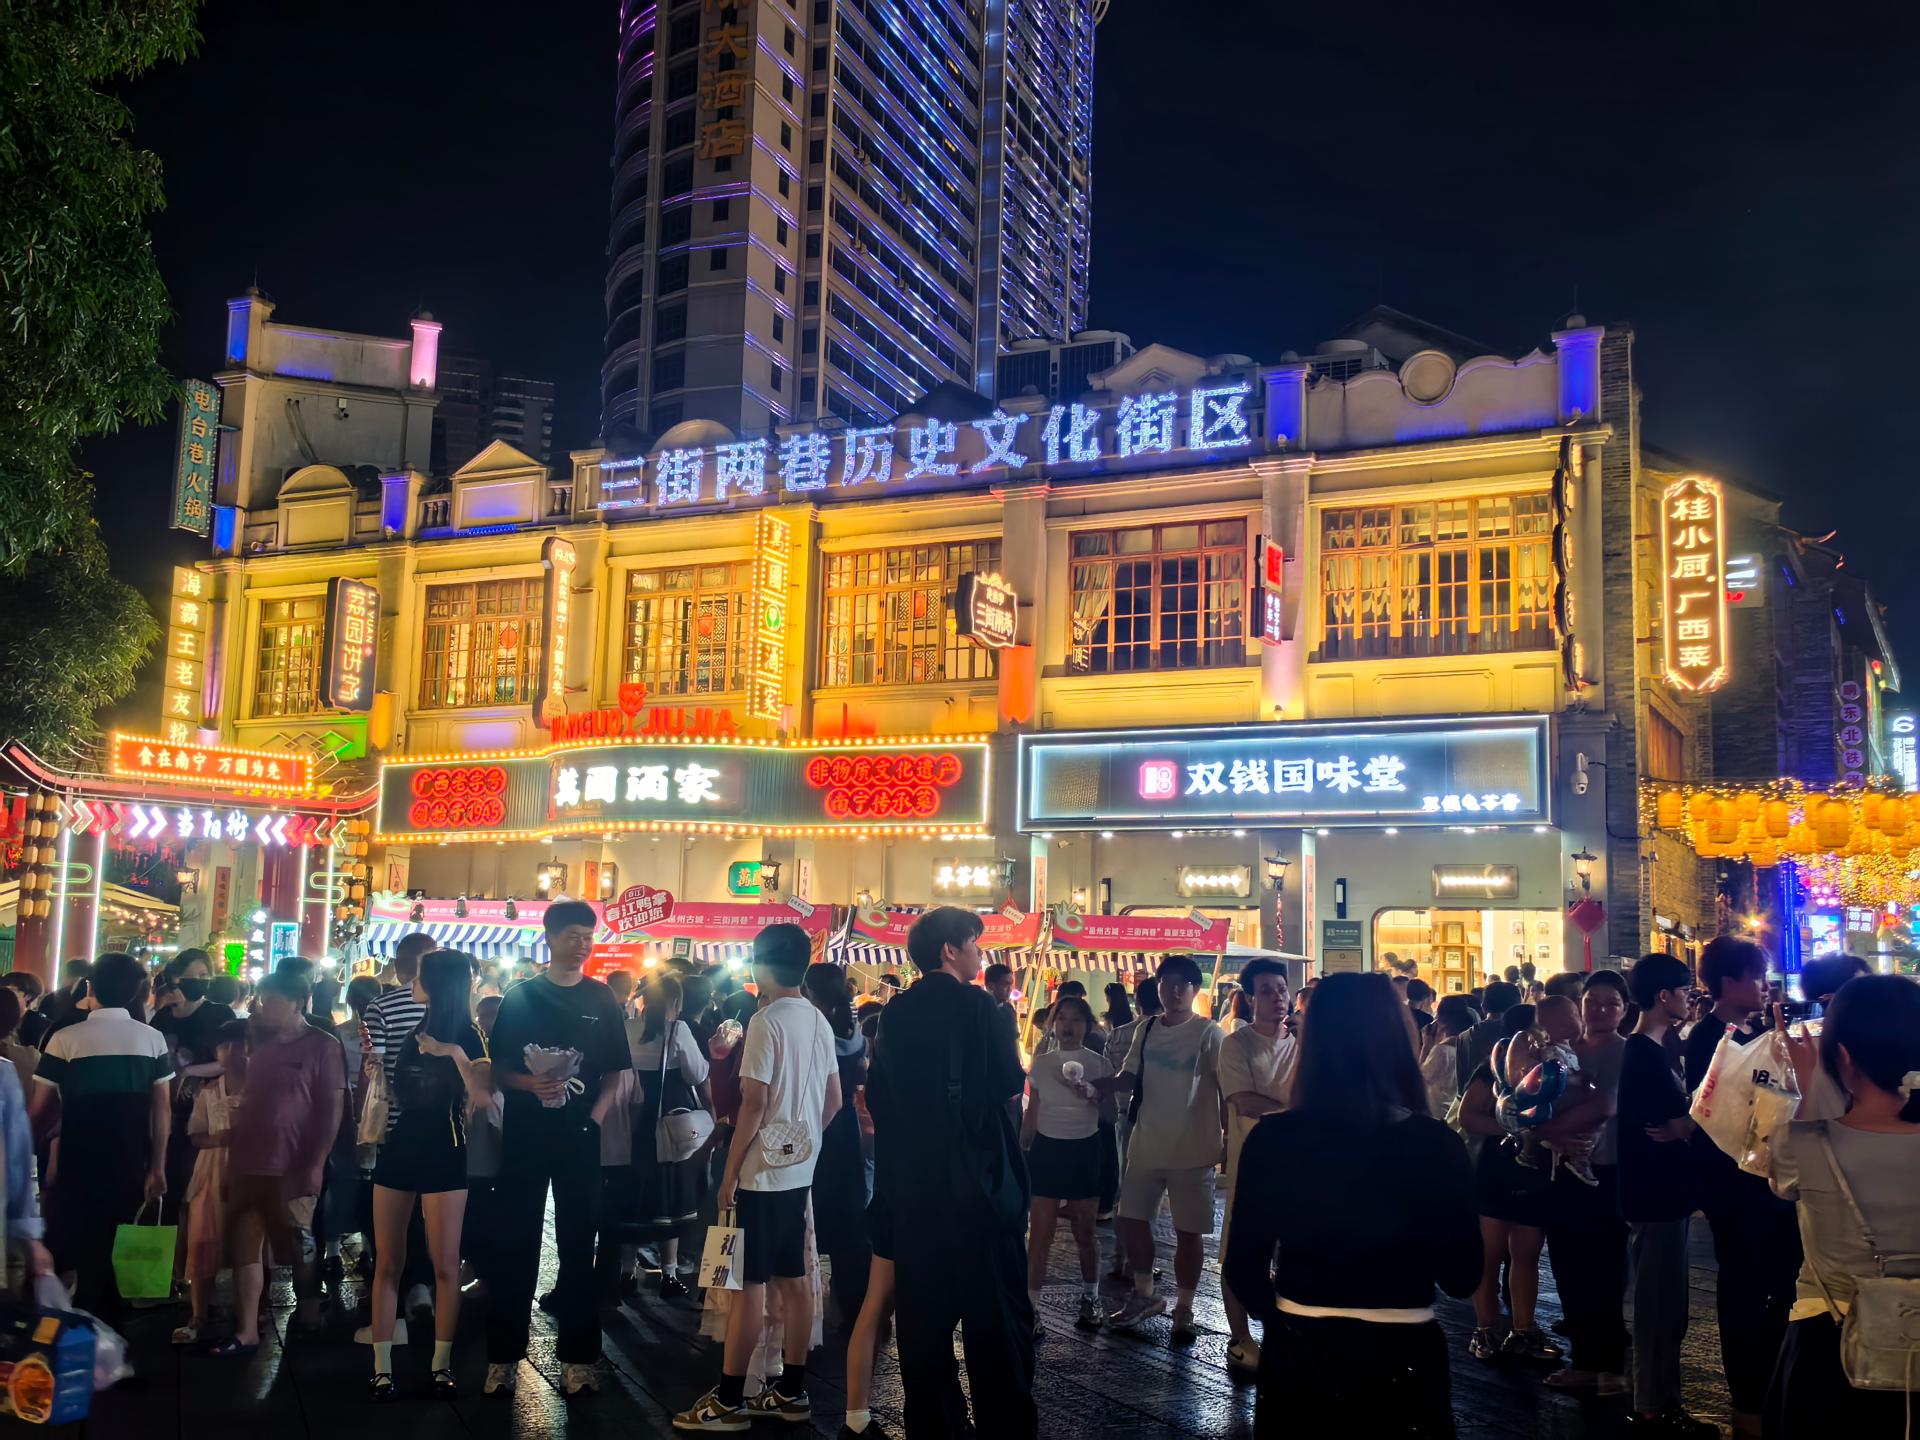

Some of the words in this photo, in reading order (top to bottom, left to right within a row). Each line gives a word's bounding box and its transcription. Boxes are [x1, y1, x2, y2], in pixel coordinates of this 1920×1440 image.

[700, 0, 750, 160] 大酒店
[184, 389, 210, 519] 电台巷火锅
[598, 381, 1251, 508] 三街两巷历史文化街区
[555, 548, 576, 566] 1945
[368, 591, 376, 605] LI
[366, 610, 376, 644] YUAN
[1675, 591, 1712, 668] 广西菜
[169, 572, 201, 746] 海霸王老友粉
[551, 709, 622, 743] WANGUO
[640, 707, 686, 736] JIU
[686, 706, 736, 738] JIA
[137, 745, 208, 772] 食在南宁
[811, 759, 957, 784] 非物质文化遗产
[1184, 755, 1407, 796] 双钱国味堂
[416, 769, 505, 794] 广西老字号
[412, 802, 501, 826] 创始于1945
[830, 792, 937, 814] 南宁传承菜
[176, 807, 249, 842] 当阳街
[618, 906, 664, 931] 欢迎您
[712, 1234, 737, 1287] 礼物
